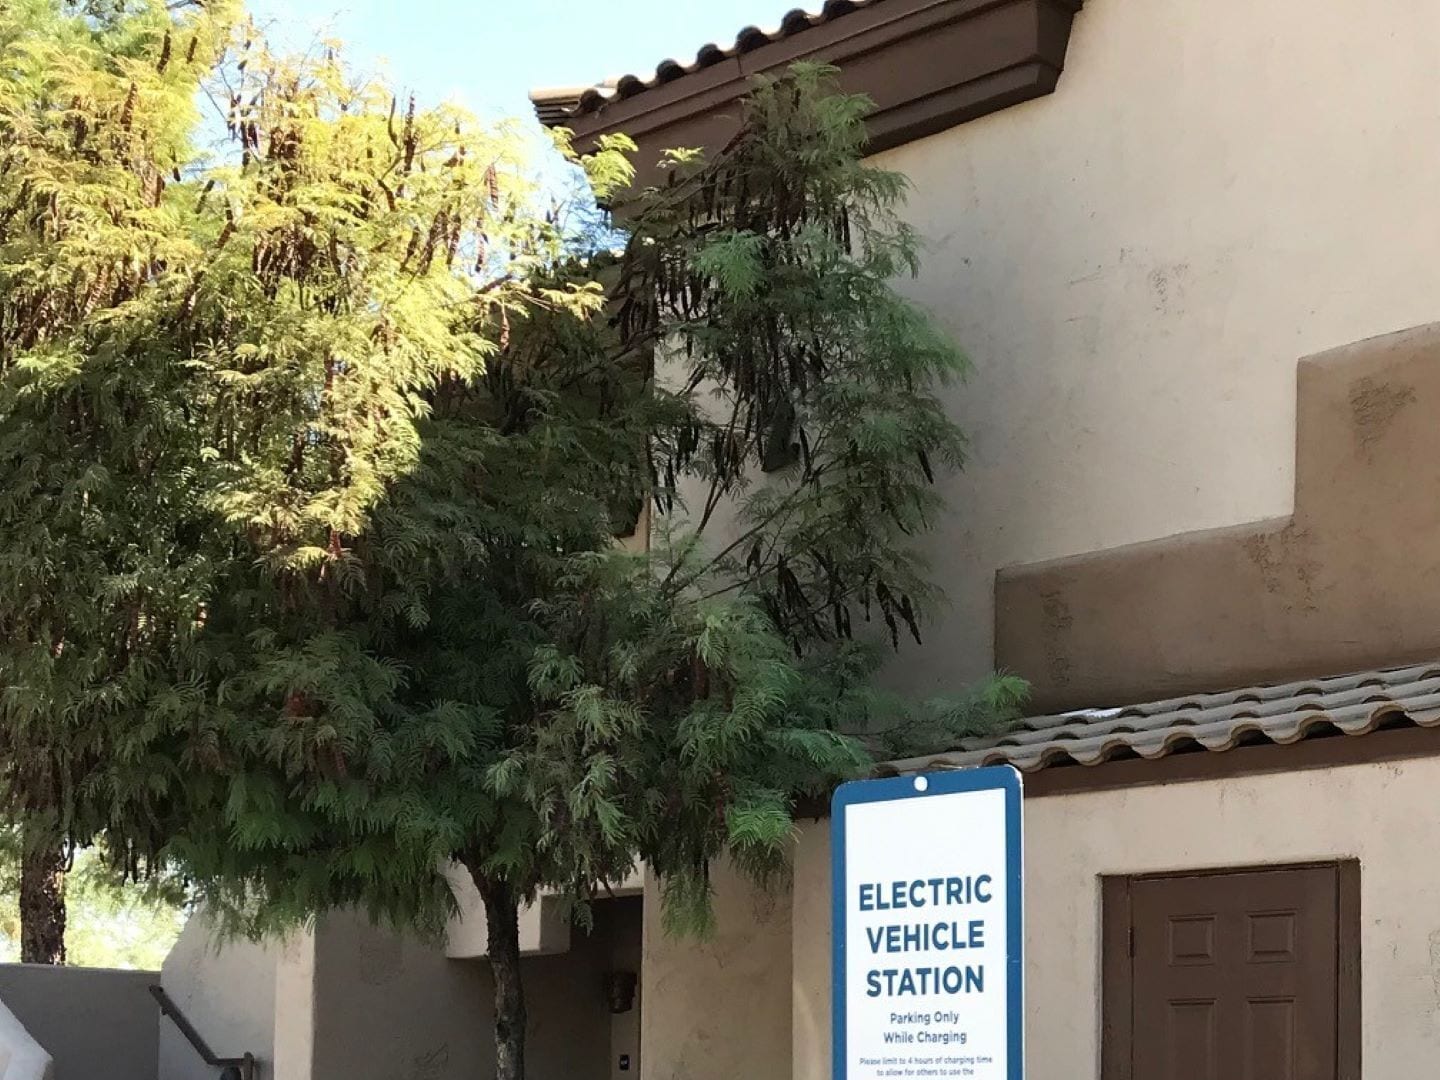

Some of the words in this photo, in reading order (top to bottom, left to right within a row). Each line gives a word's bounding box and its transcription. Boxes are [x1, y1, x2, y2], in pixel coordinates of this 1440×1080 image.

[859, 874, 993, 912] ELECTRIC
[866, 920, 985, 953] VEHICLE
[865, 965, 985, 998] STATION
[890, 1011, 931, 1025] Parking
[934, 1011, 960, 1024] Only
[883, 1031, 914, 1044] While
[917, 1030, 968, 1045] Charging
[859, 1057, 881, 1065] Please
[882, 1056, 898, 1065] limit
[899, 1057, 906, 1065] to
[908, 1056, 913, 1065] 4
[914, 1056, 933, 1065] hours
[935, 1056, 943, 1064] of
[944, 1055, 975, 1066] charging
[976, 1055, 993, 1064] time
[885, 1068, 903, 1076] allow
[905, 1068, 914, 1076] for
[916, 1068, 938, 1076] others
[939, 1068, 947, 1076] to
[949, 1068, 961, 1076] use
[962, 1067, 974, 1075] the
